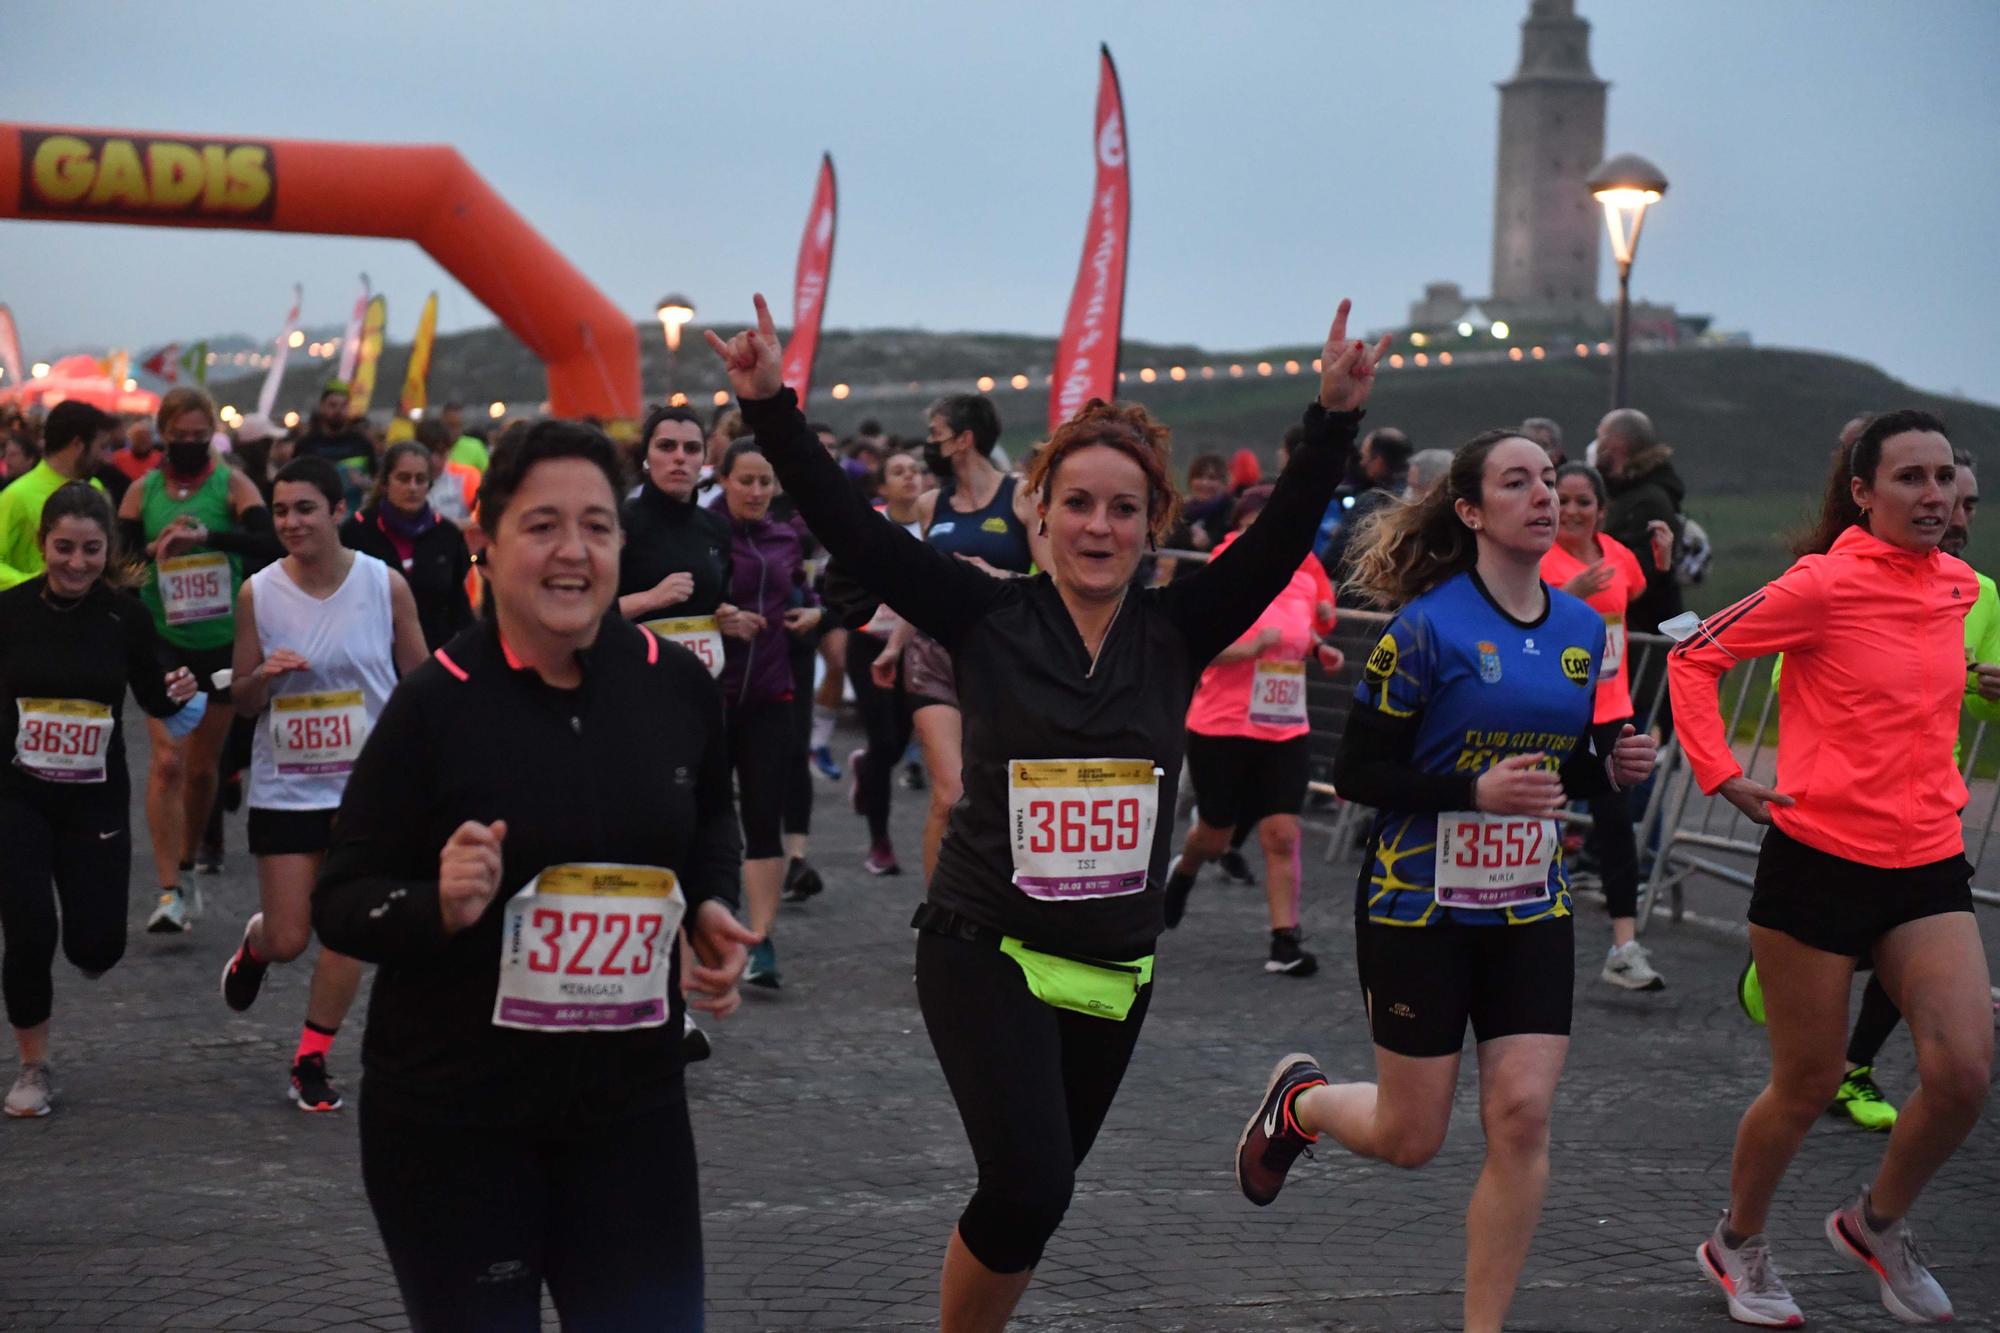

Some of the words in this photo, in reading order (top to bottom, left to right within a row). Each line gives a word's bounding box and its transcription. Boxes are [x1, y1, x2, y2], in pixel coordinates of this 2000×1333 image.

[34, 134, 272, 213] GADIS
[171, 571, 219, 600] 3195
[23, 719, 102, 756] 3630
[287, 714, 352, 751] 3631
[1029, 797, 1139, 854] 3659
[1455, 821, 1543, 869] 3552
[1077, 859, 1097, 870] ISI
[528, 908, 663, 977] 3223
